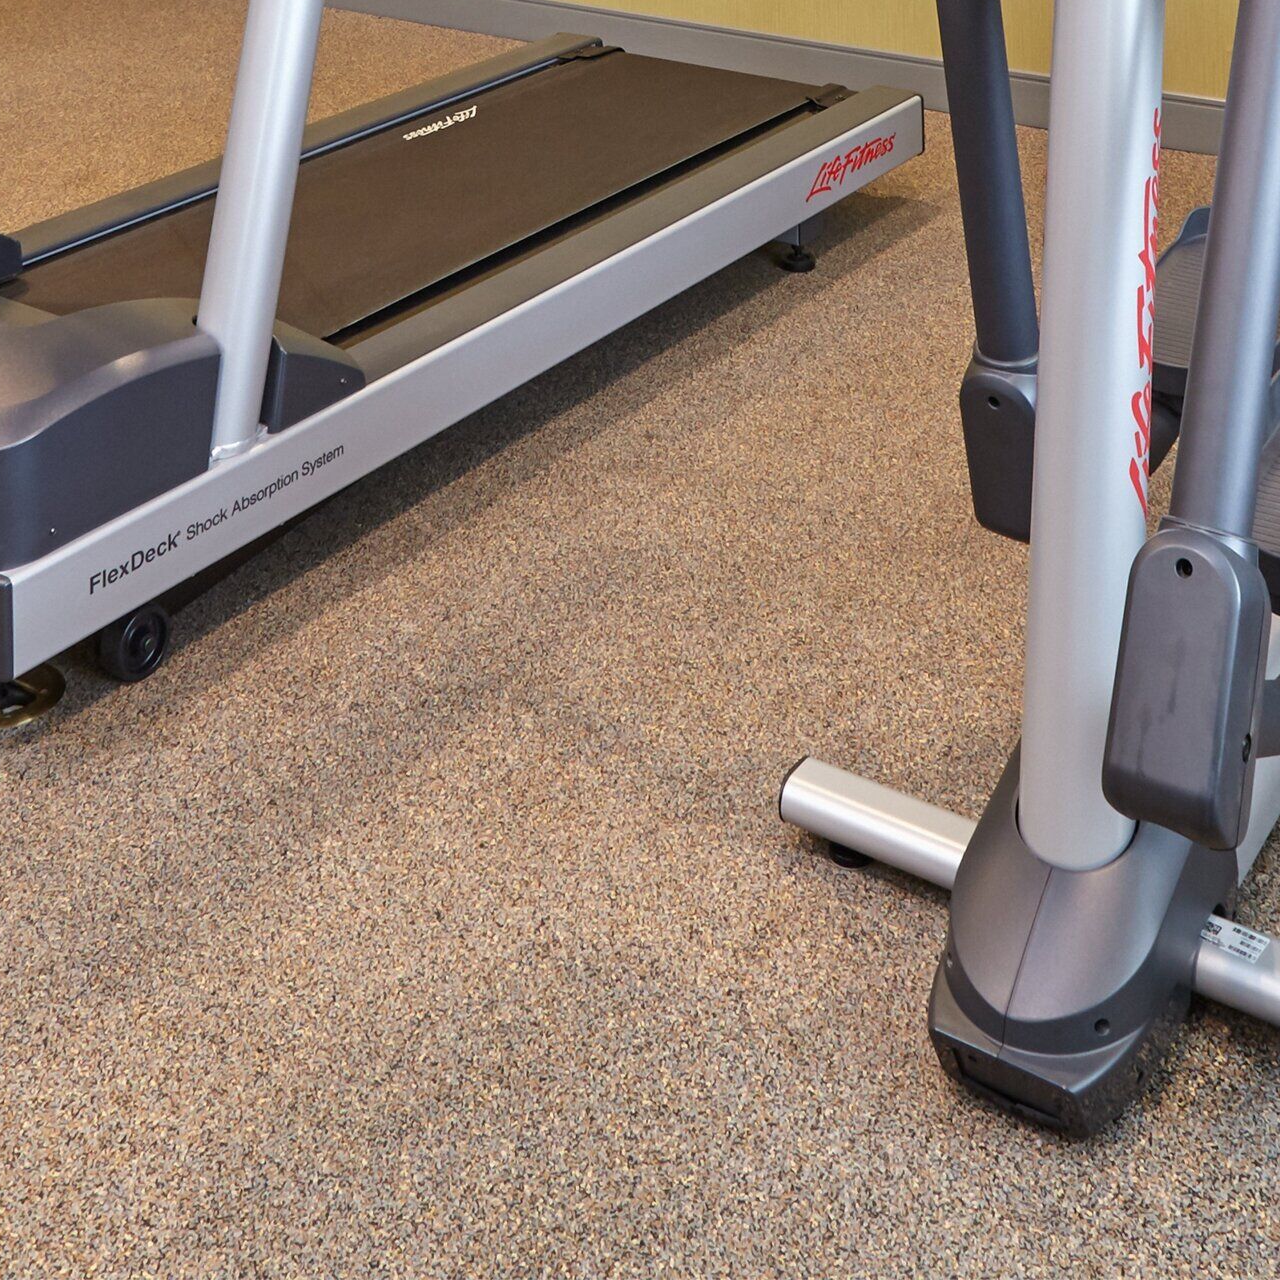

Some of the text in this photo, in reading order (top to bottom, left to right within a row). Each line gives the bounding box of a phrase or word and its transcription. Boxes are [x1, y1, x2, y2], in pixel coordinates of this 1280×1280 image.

[839, 132, 897, 186] Fitness
[186, 508, 228, 541] Shock
[231, 470, 299, 519] Absorption
[301, 444, 345, 482] System
